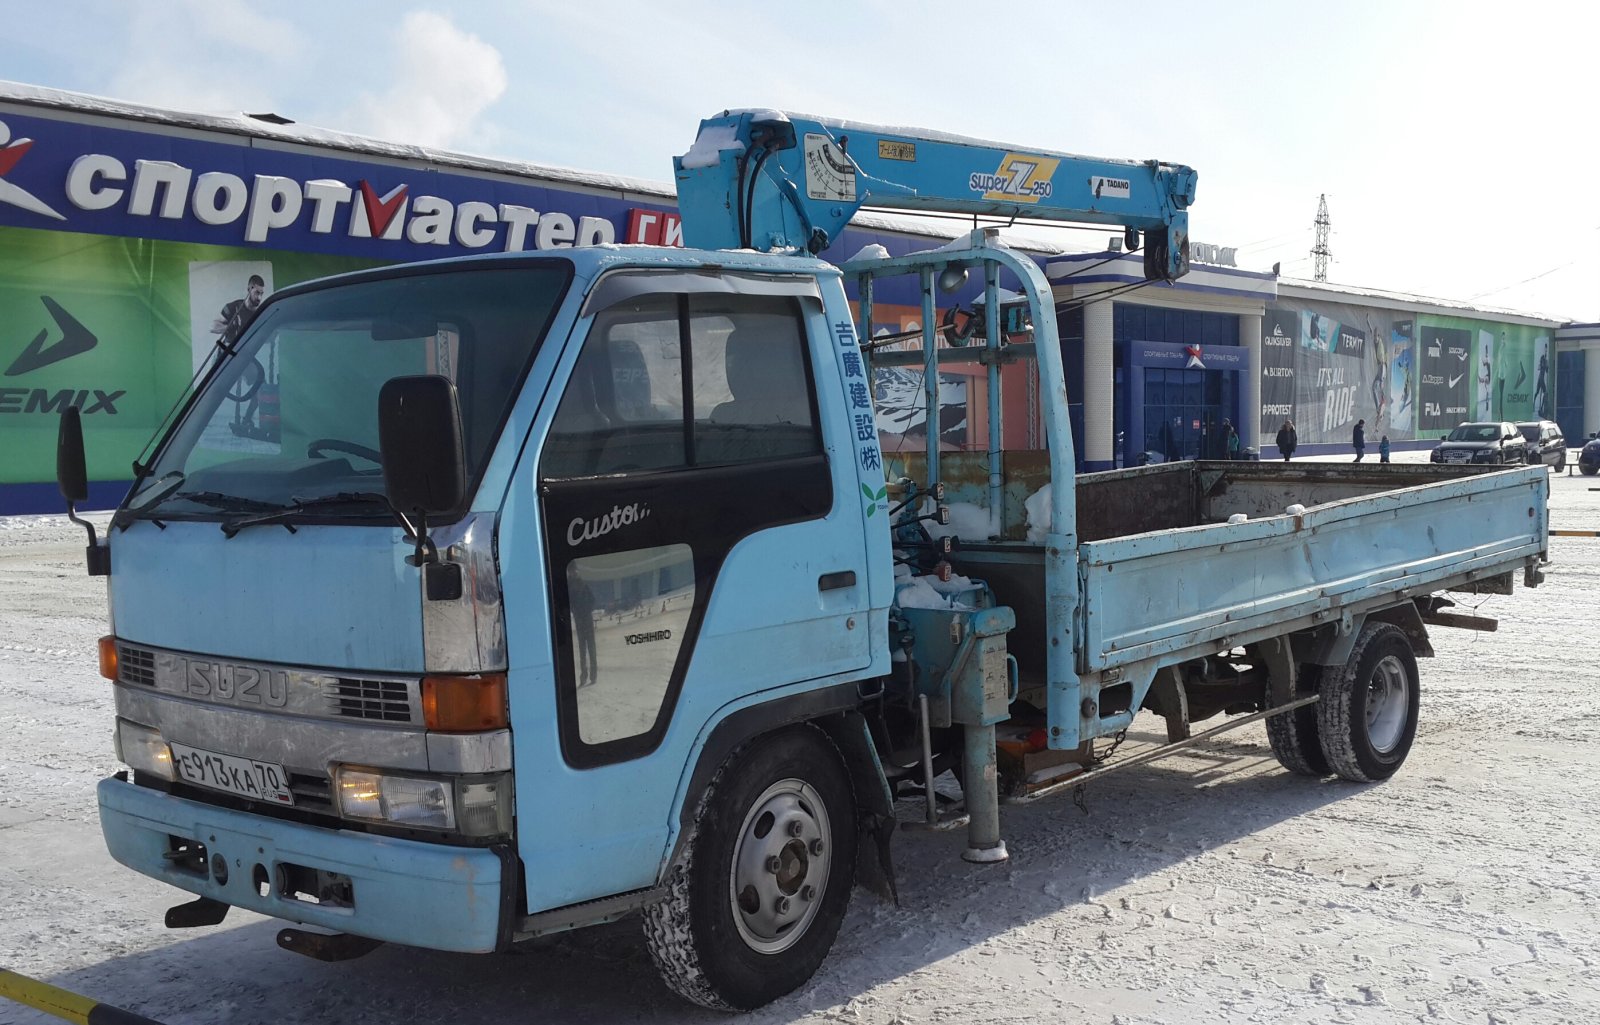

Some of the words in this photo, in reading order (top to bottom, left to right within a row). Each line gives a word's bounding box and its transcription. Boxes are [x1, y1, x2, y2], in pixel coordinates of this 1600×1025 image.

[1033, 180, 1051, 197] 250
[1106, 179, 1129, 190] TADANO
[1264, 336, 1292, 347] QUIKSILVER
[1269, 367, 1293, 378] BURTON
[1332, 368, 1345, 385] ALL
[1267, 404, 1292, 415] PROTEST
[1323, 386, 1356, 432] RIDE
[1425, 403, 1440, 416] FILA
[624, 629, 672, 645] YOSHIHIRO
[179, 657, 290, 708] ISUZU
[262, 787, 279, 799] RUS
